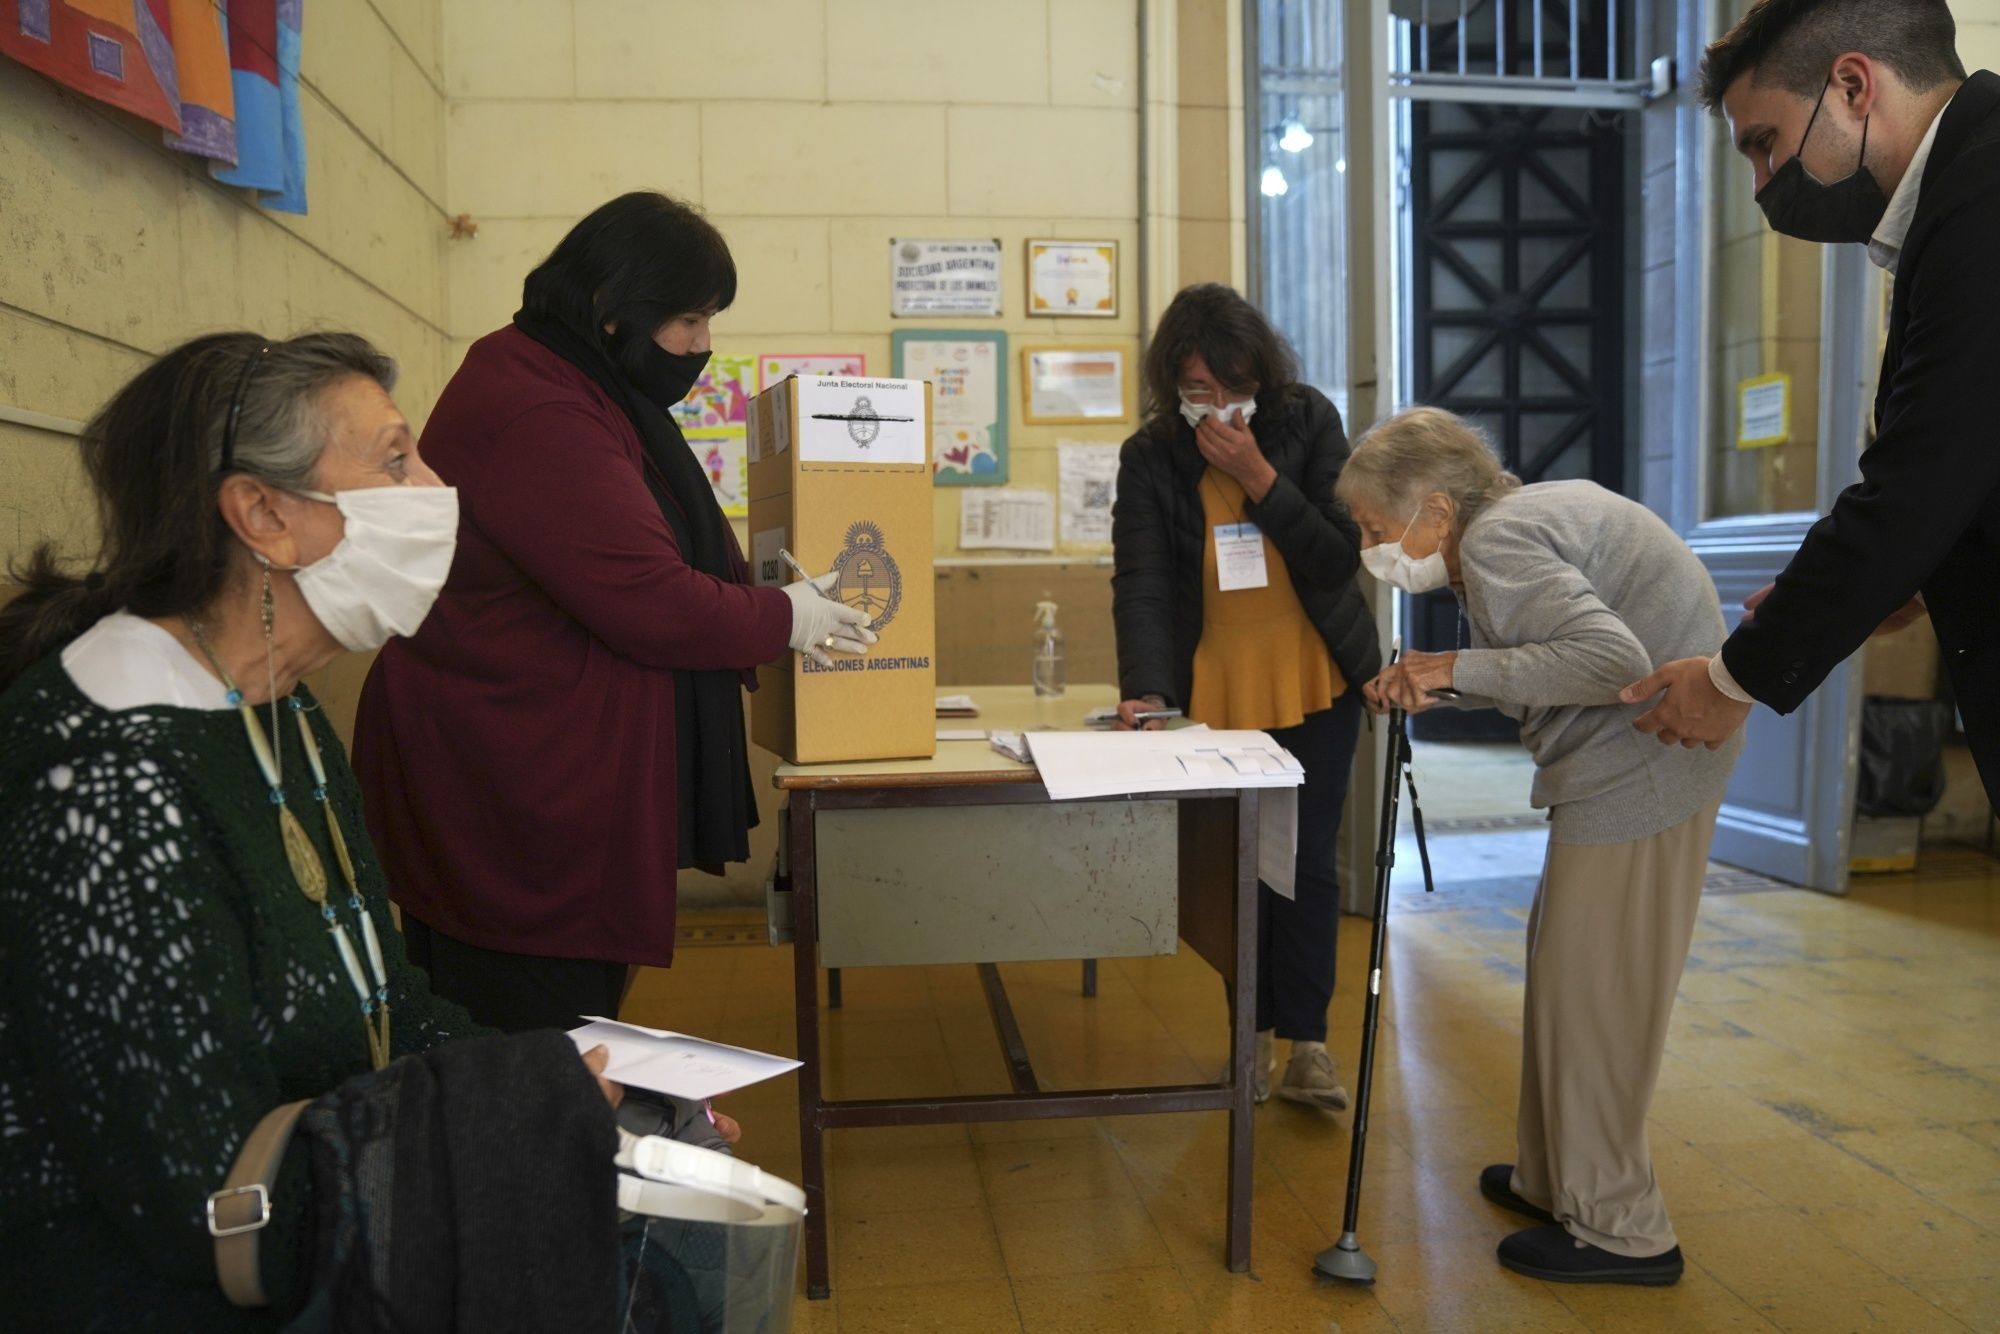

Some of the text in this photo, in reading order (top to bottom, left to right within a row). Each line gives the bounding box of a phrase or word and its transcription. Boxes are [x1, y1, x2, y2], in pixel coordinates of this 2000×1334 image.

[897, 258, 995, 278] SOCIEDAD ARGENTINA
[896, 280, 997, 291] PROTECTORA DE LOS ANIMALES
[817, 380, 908, 390] Junta Electoral Nacional
[762, 559, 779, 581] 0280
[867, 656, 930, 670] ARGENTINAS
